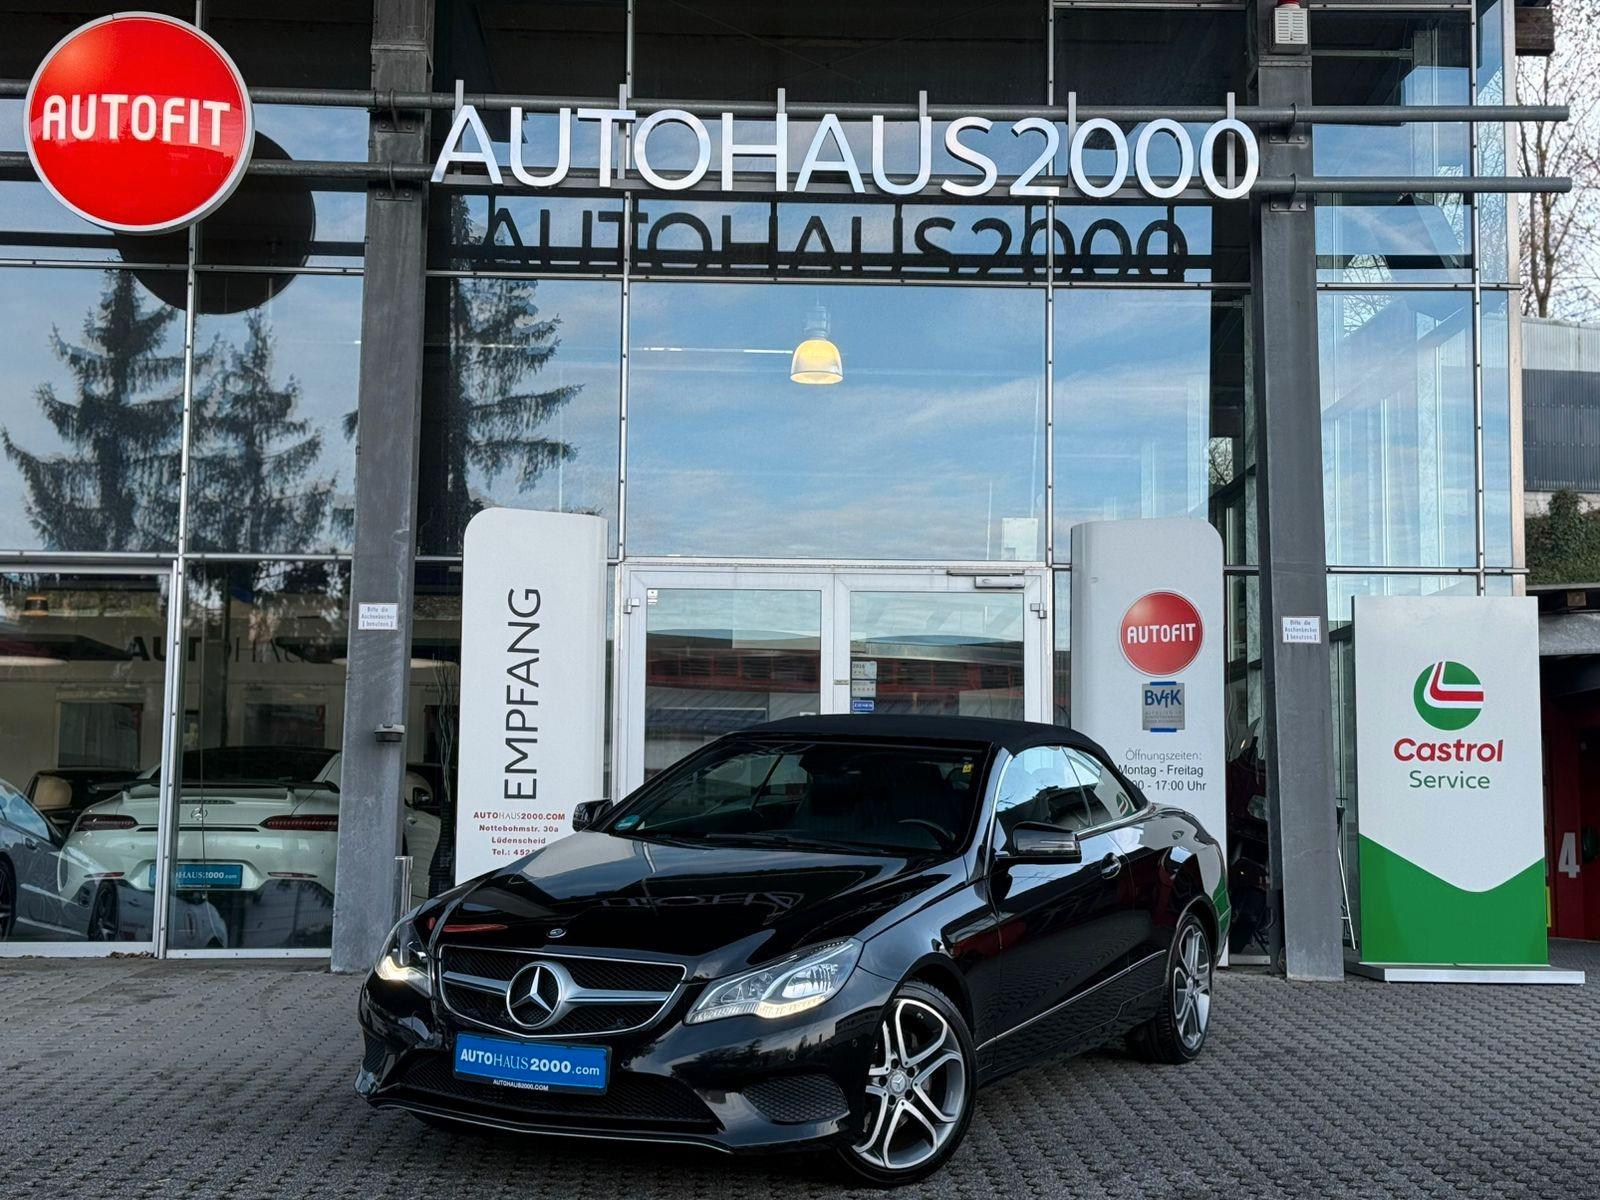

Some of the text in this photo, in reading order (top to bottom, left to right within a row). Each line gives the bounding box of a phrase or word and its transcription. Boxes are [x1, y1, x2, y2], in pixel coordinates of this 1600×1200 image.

[42, 93, 231, 147] AUTOFIT
[1127, 623, 1196, 644] AUTOFIT
[504, 588, 541, 800] EMPFANG
[1125, 747, 1203, 764] Öffnungszeiten:
[1393, 738, 1504, 762] Castrol
[1118, 764, 1157, 778] Montag
[1167, 764, 1204, 778] Freitag
[1155, 780, 1184, 791] 17:00
[1187, 780, 1207, 791] Uhr
[1409, 770, 1491, 789] Service
[473, 811, 566, 820] AUTOHAUS2000.COM
[479, 824, 540, 833] Nottebohmstr.
[491, 836, 546, 844] Lüdenscheid
[492, 848, 511, 856] Tel.:
[1558, 831, 1581, 879] 4
[493, 1079, 549, 1091] AUTOHAUS2000.COM
